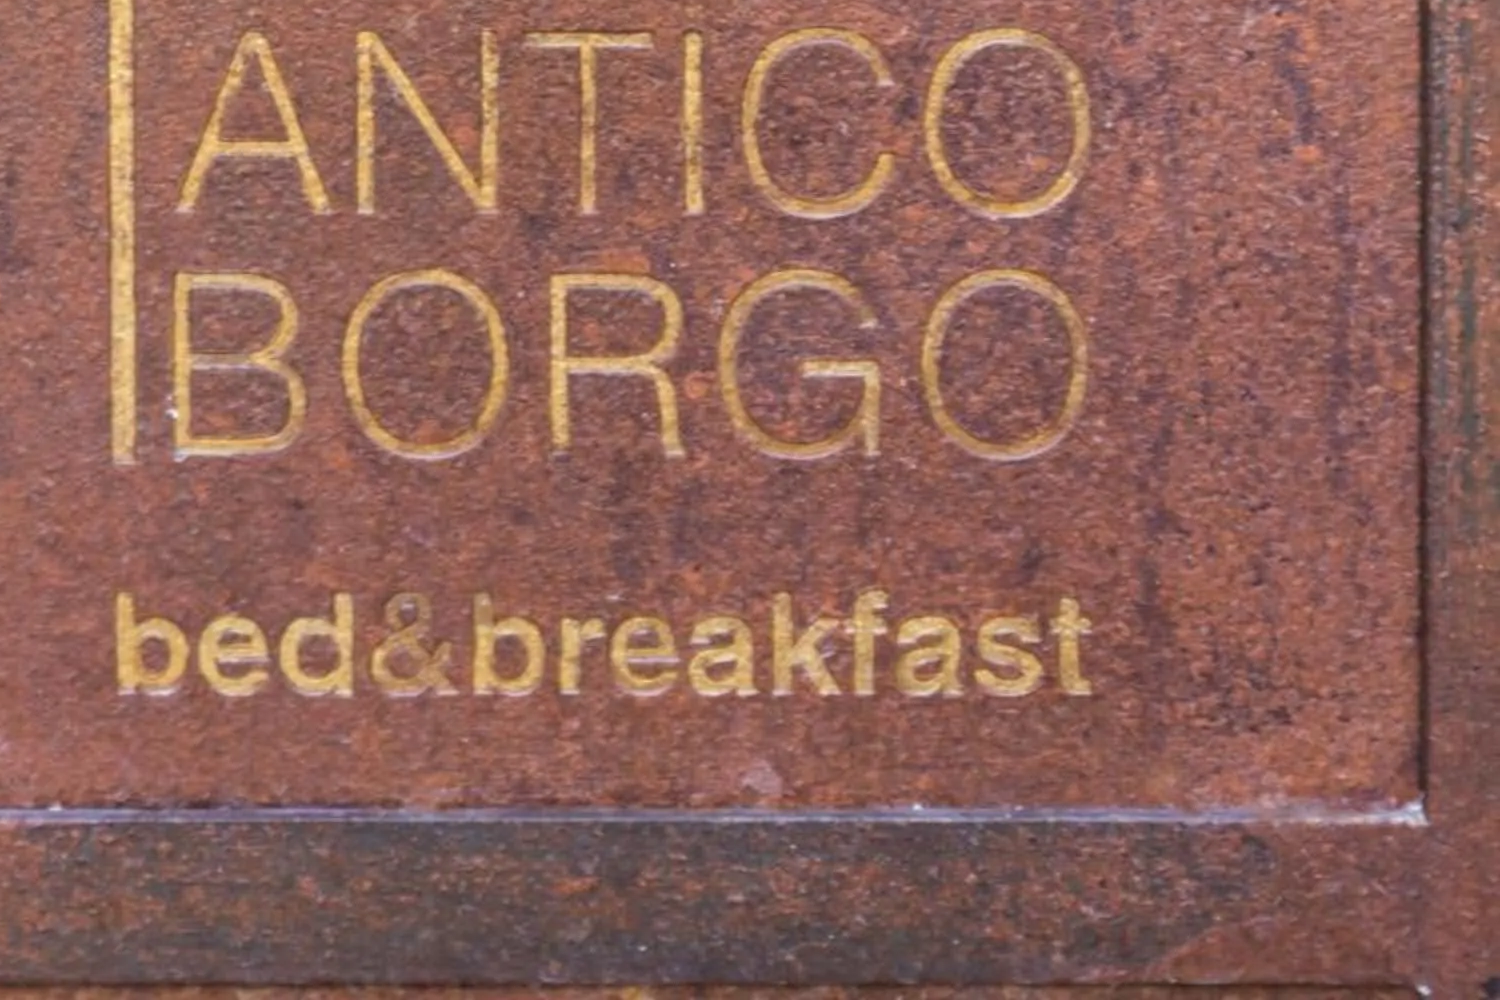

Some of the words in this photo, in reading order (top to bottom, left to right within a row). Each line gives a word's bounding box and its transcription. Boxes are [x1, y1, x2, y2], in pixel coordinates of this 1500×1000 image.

[176, 26, 1090, 218] ANTICO
[173, 267, 1088, 460] BORGO
[115, 590, 1092, 697] bed&breakfast
